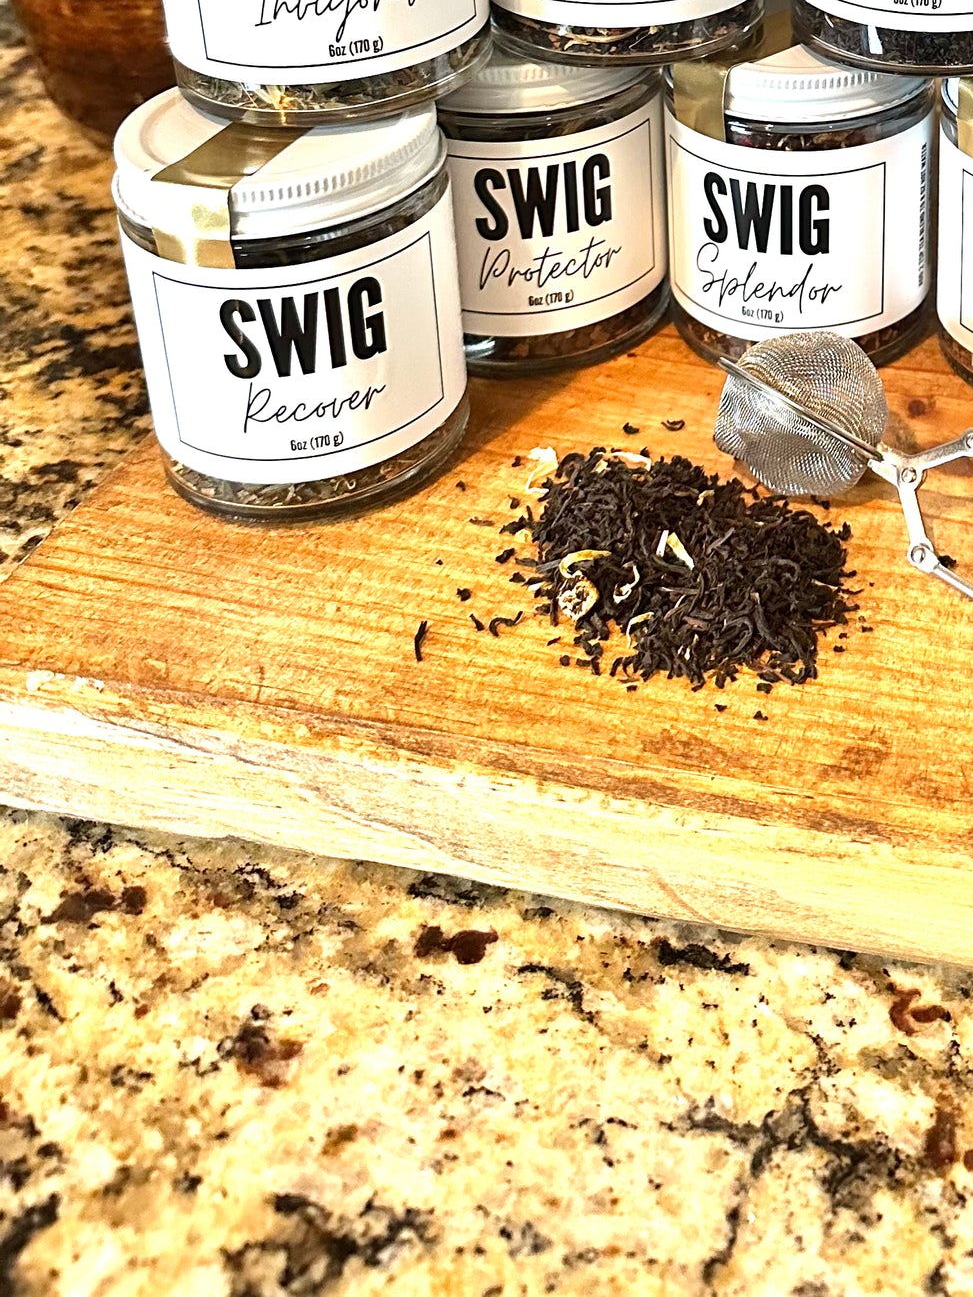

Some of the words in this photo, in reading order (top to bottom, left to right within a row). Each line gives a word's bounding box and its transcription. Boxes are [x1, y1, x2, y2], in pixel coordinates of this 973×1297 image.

[329, 45, 346, 57] 6oz
[349, 40, 371, 56] (170
[372, 36, 384, 53] g)
[474, 154, 612, 241] SWIG
[703, 172, 829, 255] SWIG
[479, 236, 622, 290] Protector
[696, 242, 843, 314] Splendor
[528, 296, 543, 306] 6oz
[545, 292, 562, 305] (170
[565, 290, 574, 303] g)
[742, 306, 754, 317] 6oz
[757, 309, 772, 319] (170
[775, 311, 783, 323] g)
[220, 277, 387, 379] SWIG
[244, 382, 386, 433] Recover
[291, 440, 307, 451] 6oz
[310, 435, 330, 450] (170
[334, 431, 343, 447] g)
